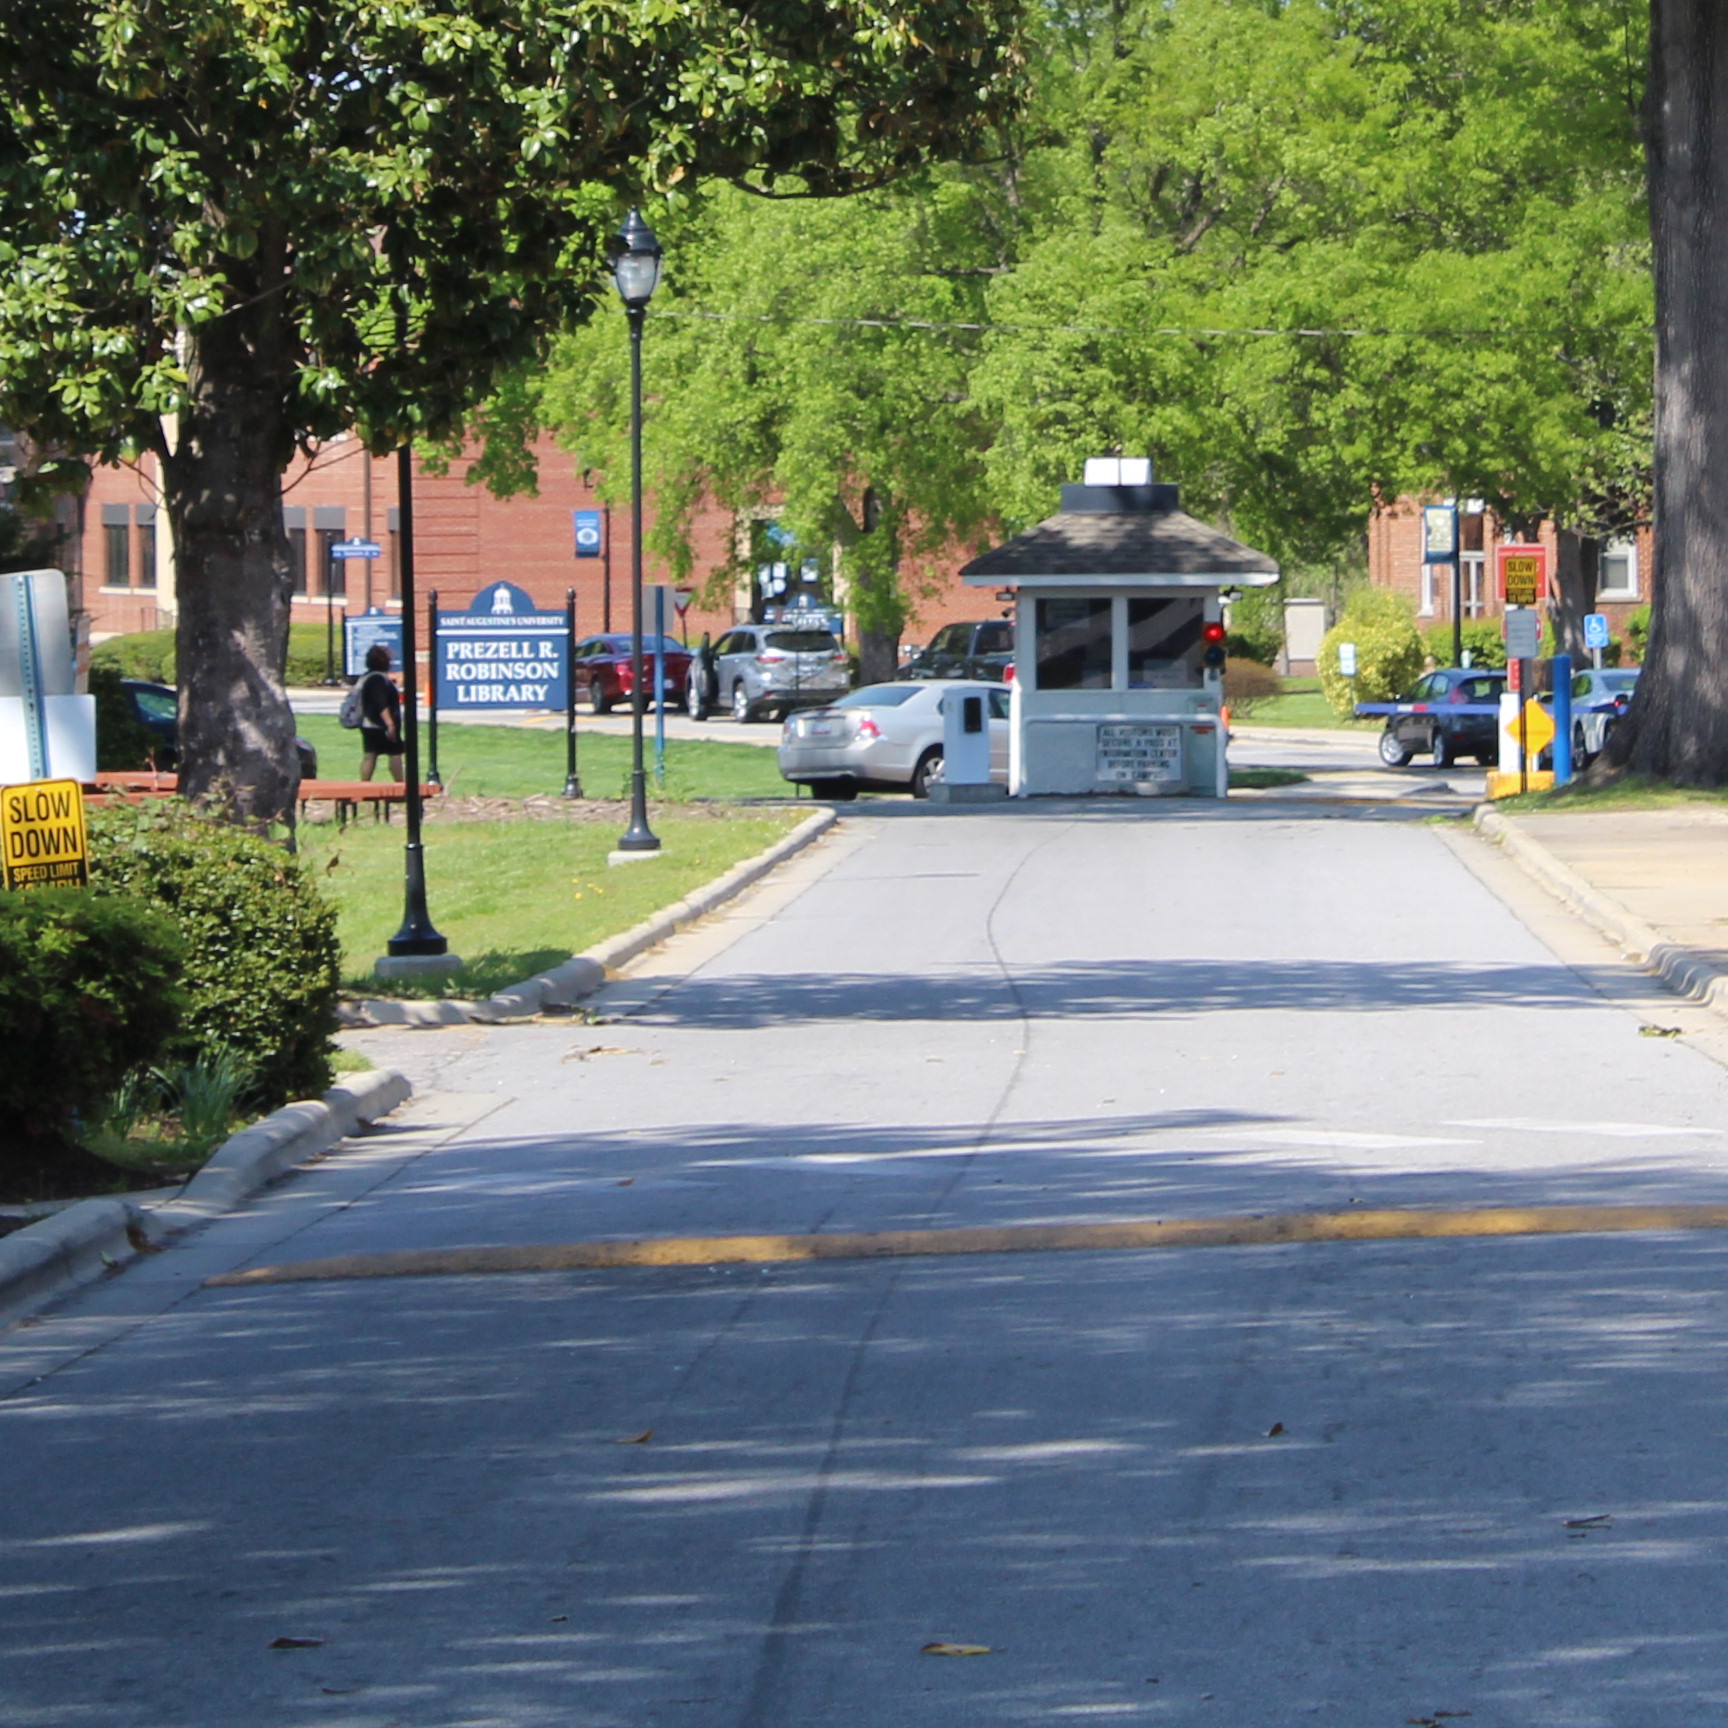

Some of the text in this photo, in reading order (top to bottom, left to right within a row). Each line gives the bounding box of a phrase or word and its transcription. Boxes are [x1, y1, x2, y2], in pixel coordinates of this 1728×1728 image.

[1507, 561, 1533, 572] SLOW
[1508, 574, 1534, 585] DOWN
[440, 616, 466, 626] SAINT
[517, 615, 564, 626] UNIVERSITY
[446, 641, 559, 659] PREZELL R.
[446, 662, 560, 680] ROBINSON
[457, 684, 549, 702] LIBRARY
[1119, 728, 1153, 737] VISITORS
[1155, 728, 1177, 737] MUST
[1100, 749, 1178, 758] INFORMATION CENTER
[1137, 760, 1170, 769] PARKING
[9, 790, 71, 824] SLOW
[10, 826, 78, 859] DOWN
[13, 862, 79, 883] SPEED LIMIT
